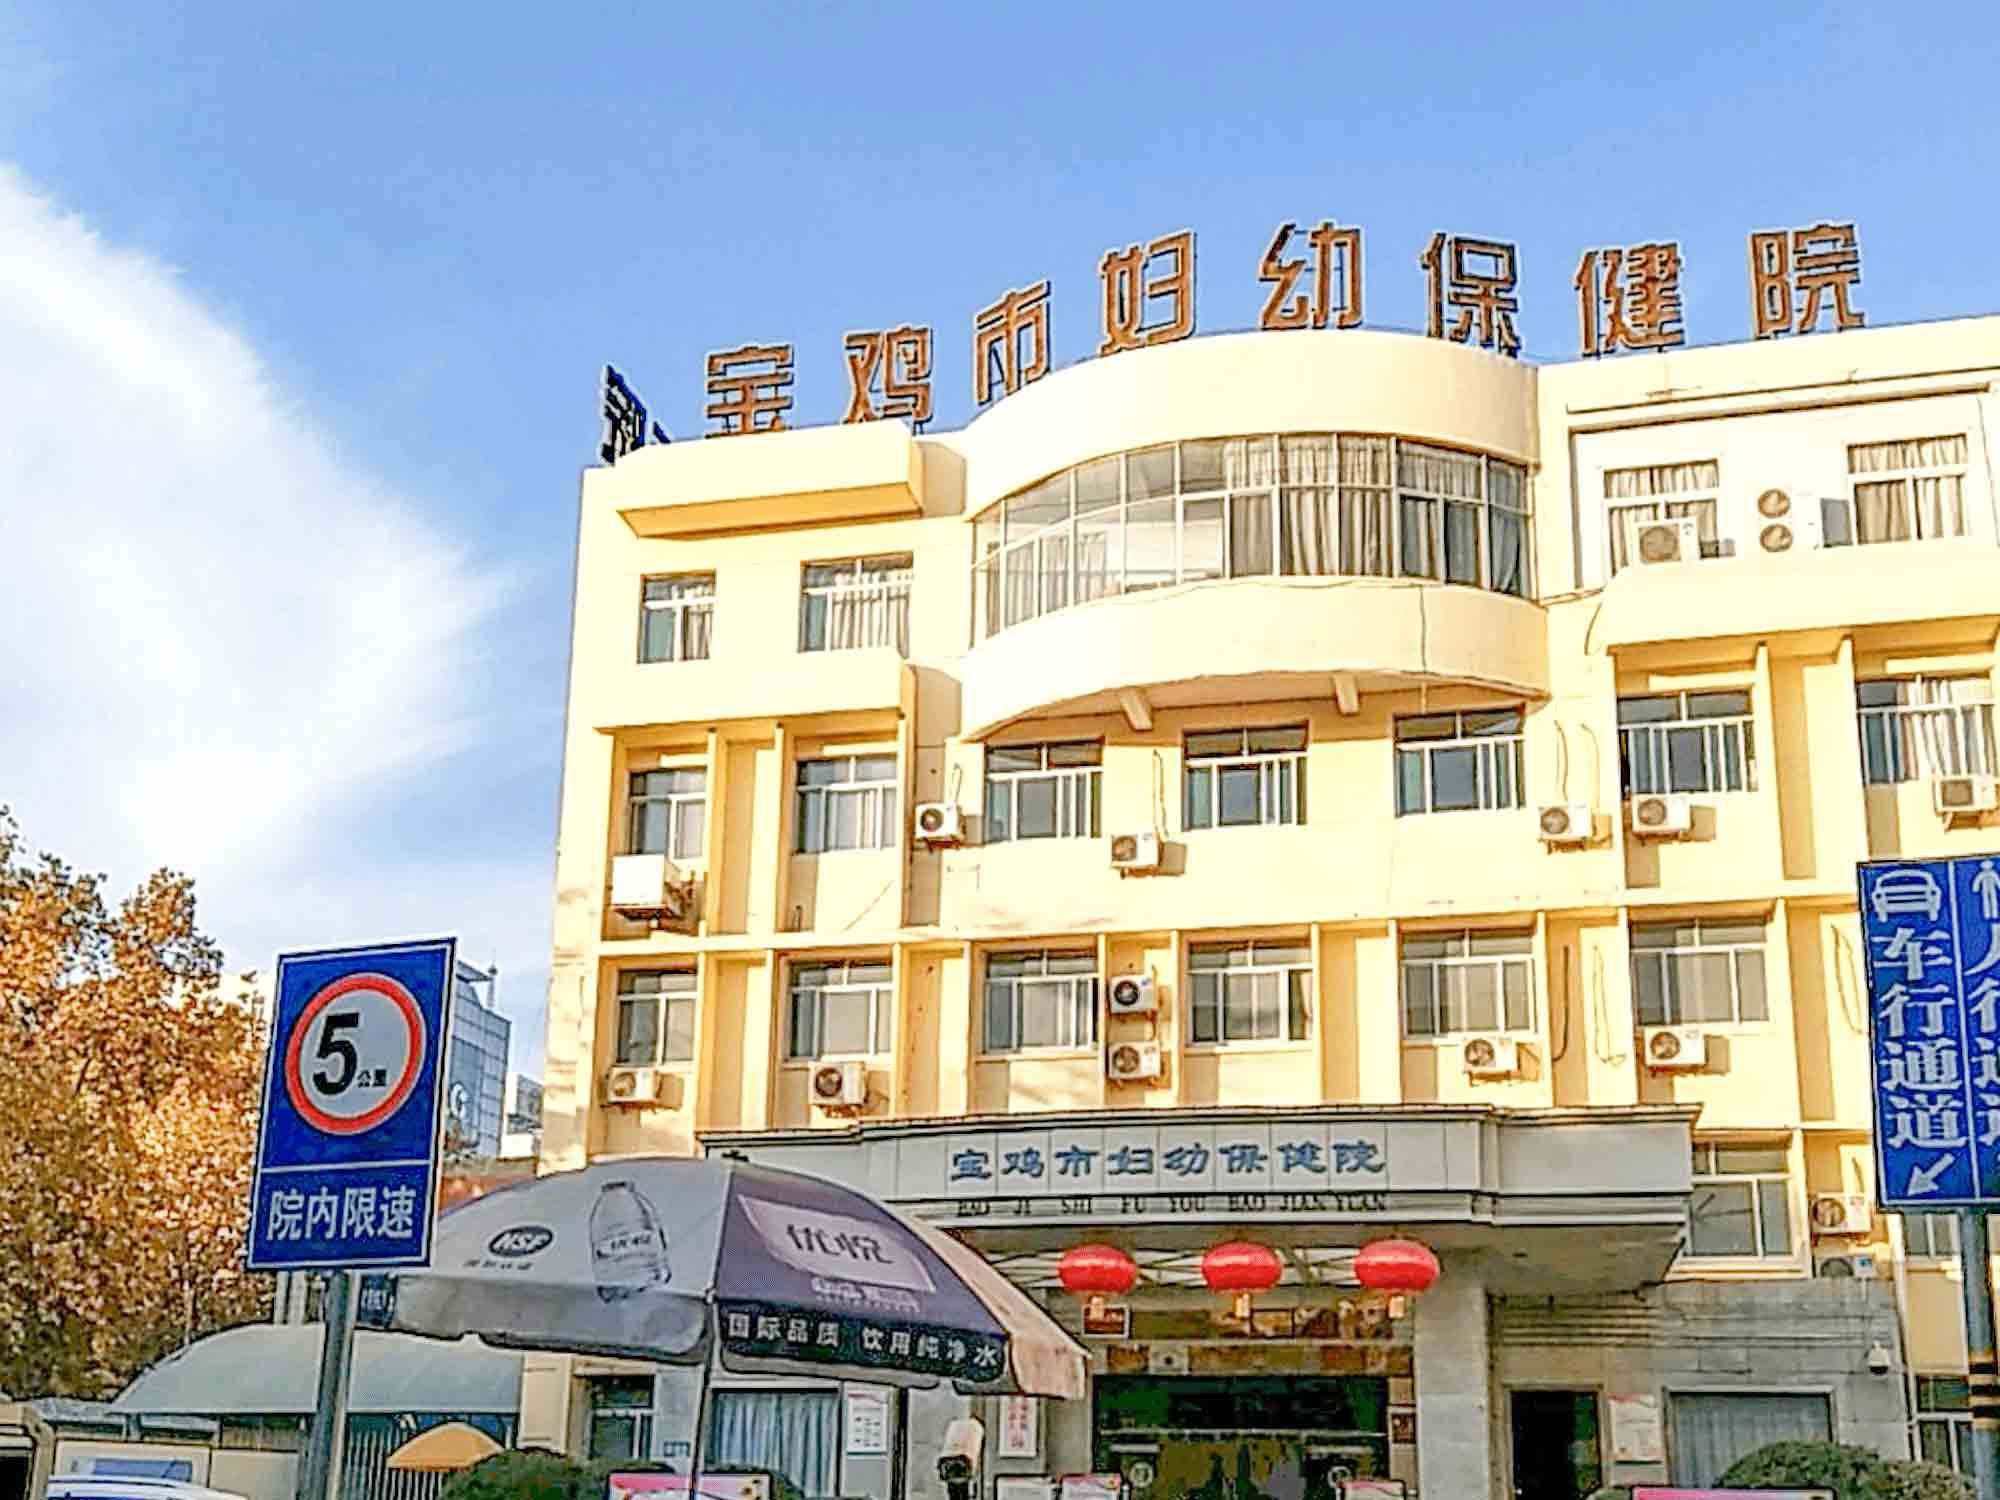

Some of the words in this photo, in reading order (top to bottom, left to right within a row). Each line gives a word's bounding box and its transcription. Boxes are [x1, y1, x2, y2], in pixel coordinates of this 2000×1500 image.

[706, 221, 1866, 436] 宝鸡市妇幼保健院
[312, 1012, 359, 1096] 5
[1871, 927, 1970, 1150] 车行通道
[951, 1140, 1386, 1182] 宝鸡市妇幼保健院
[266, 1186, 417, 1241] 院内限速
[727, 1313, 840, 1347] 国际品质
[862, 1327, 999, 1368] 饮用纯净水
